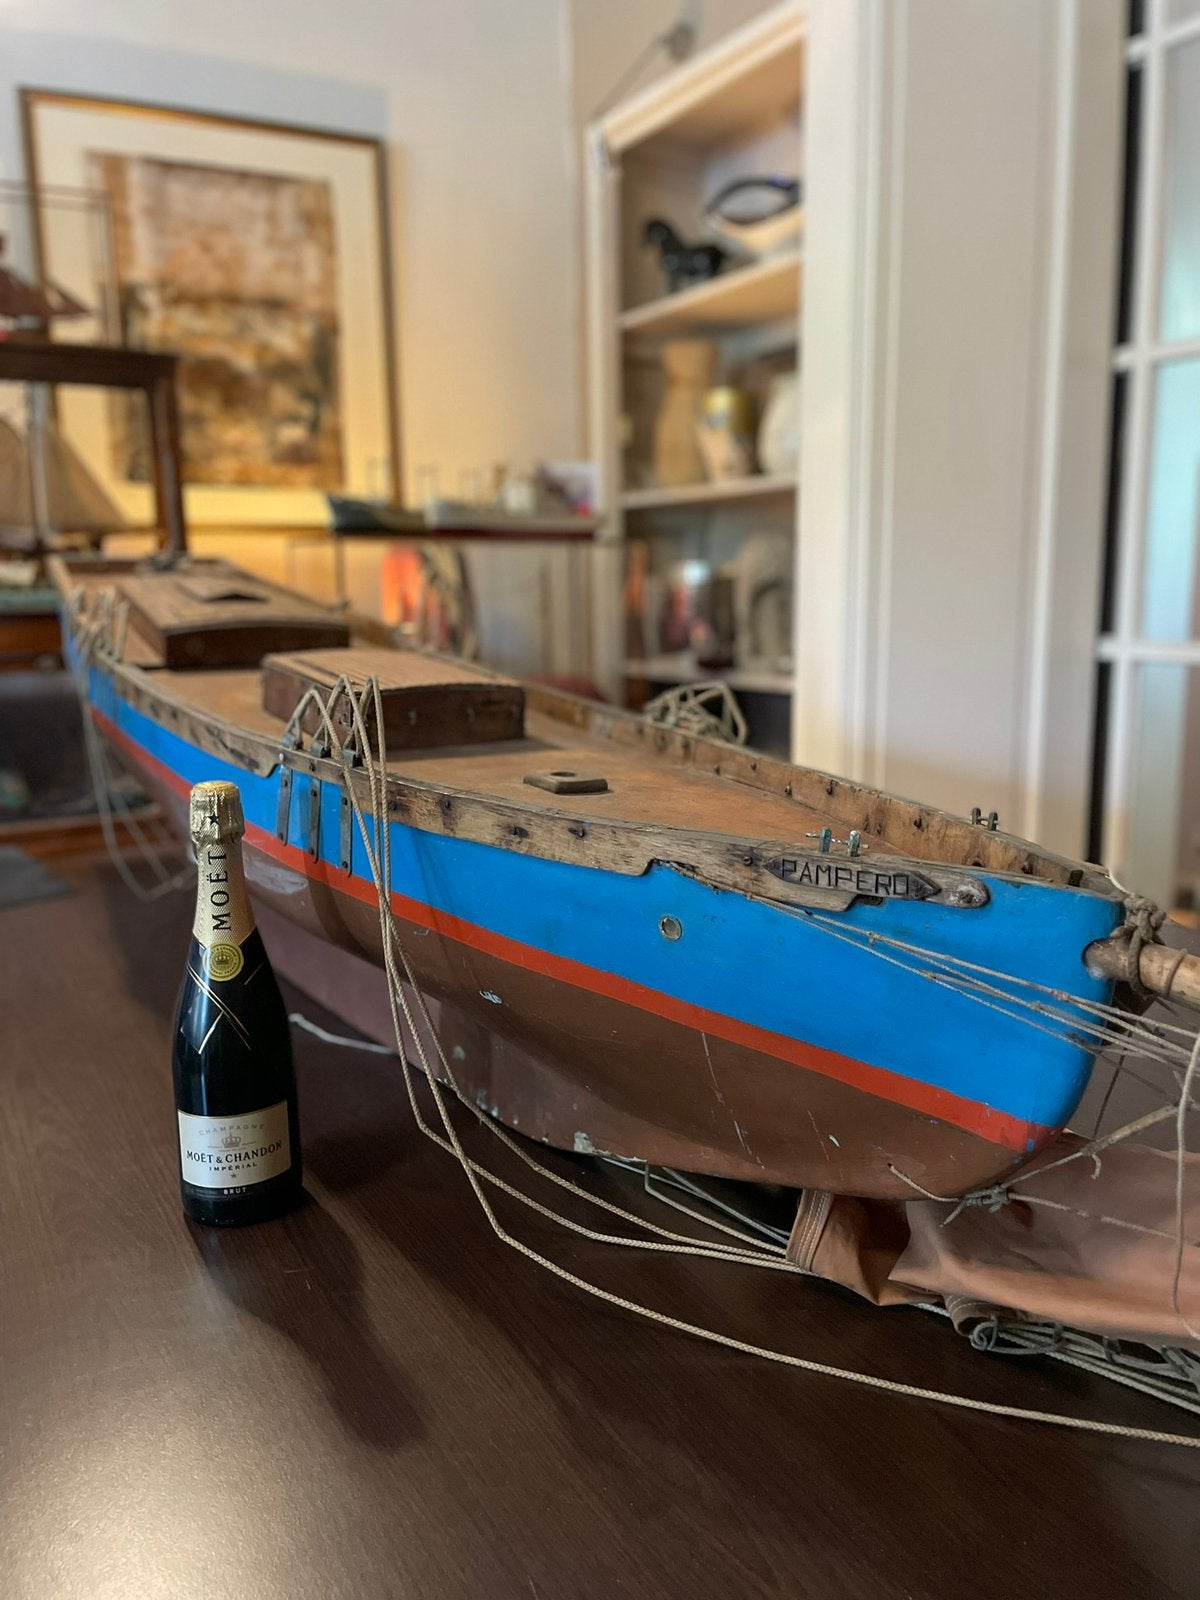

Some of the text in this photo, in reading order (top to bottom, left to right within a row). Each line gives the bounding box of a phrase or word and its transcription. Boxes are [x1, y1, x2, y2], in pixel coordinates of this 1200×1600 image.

[781, 858, 910, 897] PAMPERO
[207, 851, 231, 931] MOËT
[198, 1123, 265, 1136] CHAMPAGNE
[215, 1155, 223, 1164] &
[225, 1139, 282, 1163] CHANDON
[223, 1187, 247, 1195] BRUT
